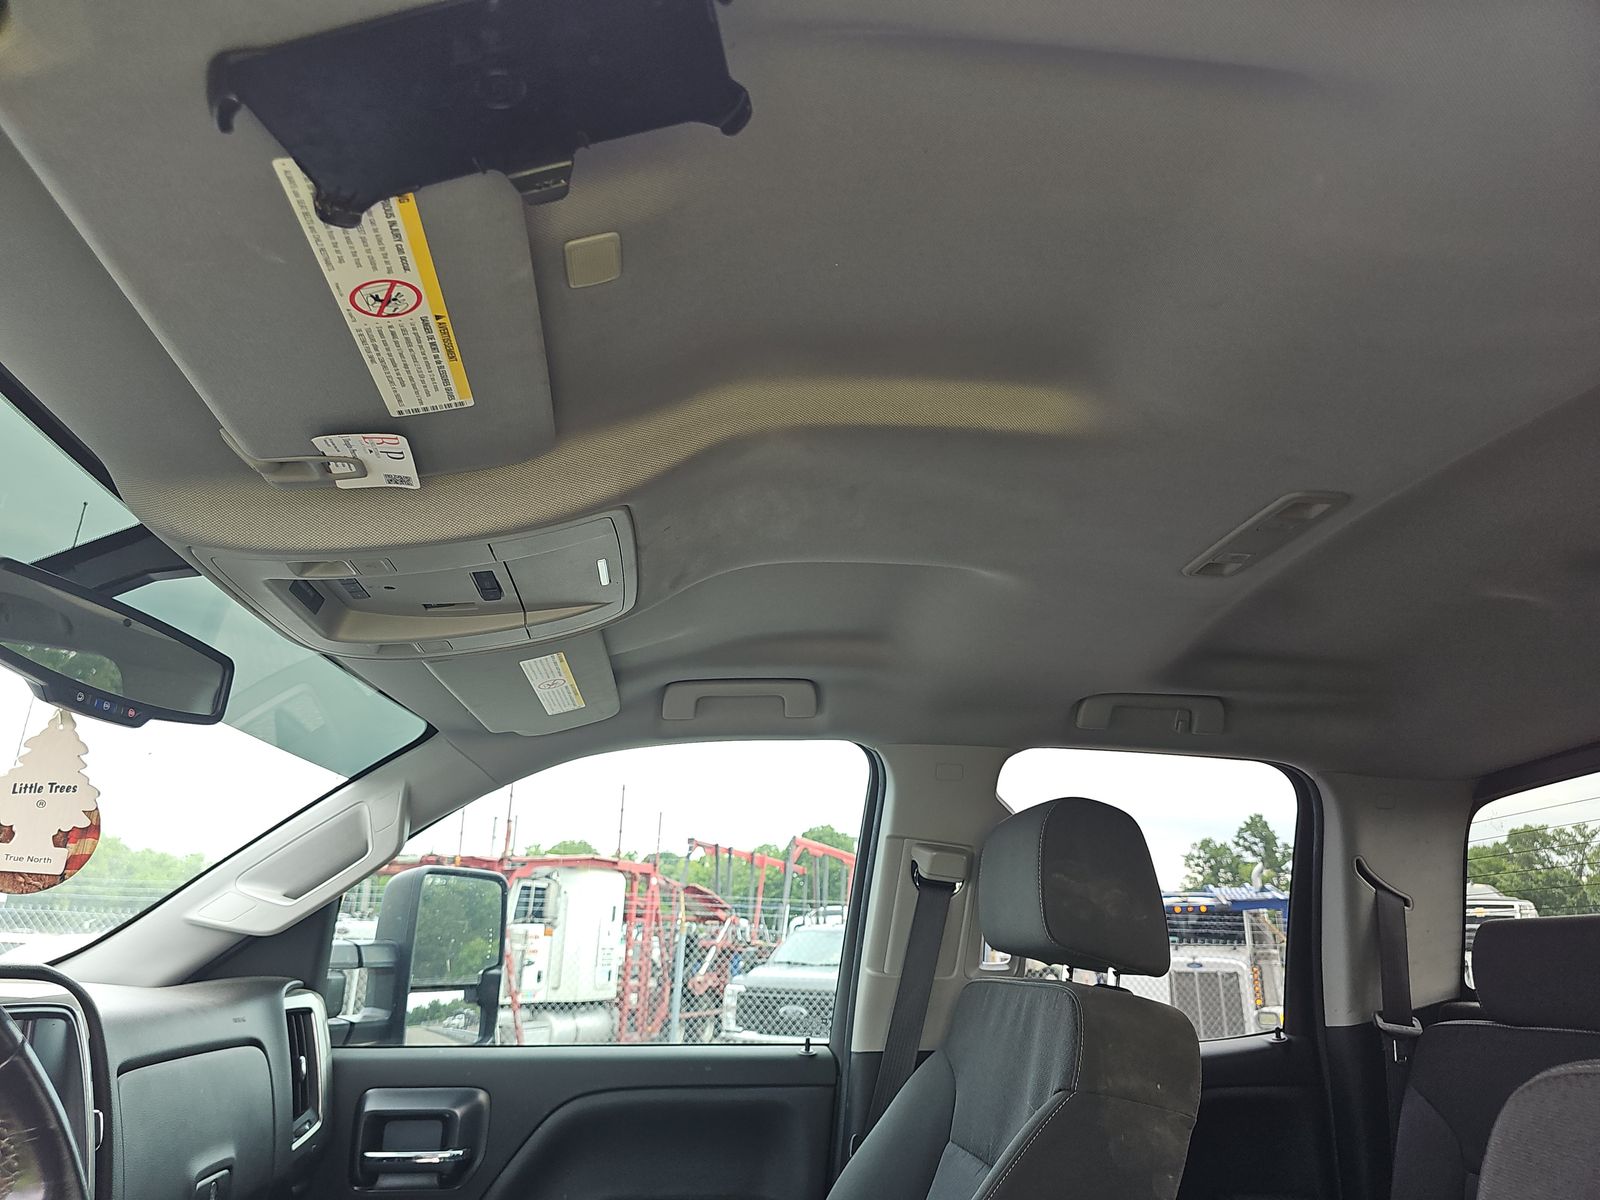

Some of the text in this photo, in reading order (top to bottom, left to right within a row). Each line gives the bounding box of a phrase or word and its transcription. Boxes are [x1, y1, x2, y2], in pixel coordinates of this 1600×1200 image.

[386, 219, 403, 243] INJURY
[12, 782, 78, 794] Little Trees
[5, 853, 52, 864] True North
